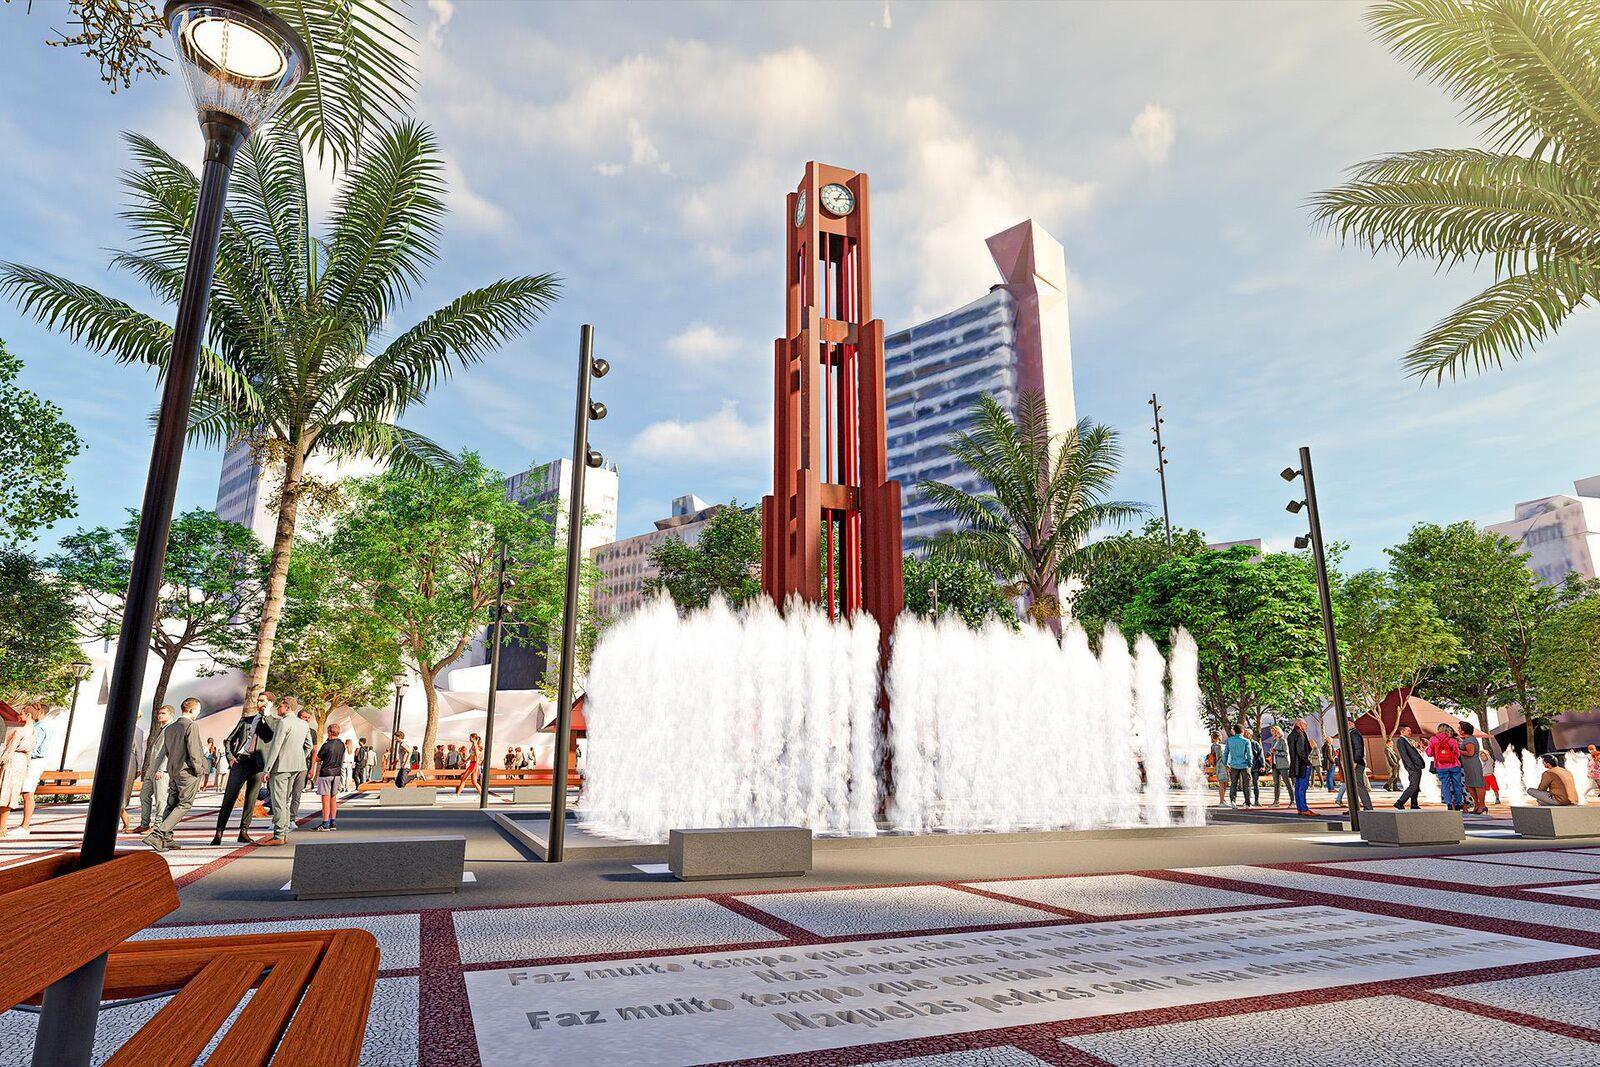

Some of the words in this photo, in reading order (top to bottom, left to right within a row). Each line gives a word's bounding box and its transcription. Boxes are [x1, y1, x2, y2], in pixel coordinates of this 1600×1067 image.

[508, 972, 576, 986] Faz
[584, 962, 685, 979] muito
[690, 955, 798, 970] tempo
[805, 950, 863, 962] que
[868, 946, 909, 954] eu
[907, 940, 966, 951] não
[962, 935, 1028, 946] vejo
[1045, 928, 1126, 939] verde
[1128, 950, 1245, 965] branco
[1230, 945, 1286, 955] da
[751, 969, 828, 983] Nas
[824, 955, 999, 976] longarinas
[995, 950, 1044, 960] da
[1036, 943, 1124, 959] ponte
[1114, 937, 1201, 948] velha
[1046, 960, 1122, 975] vejo
[1117, 960, 1148, 968] o
[939, 975, 990, 986] eu
[983, 967, 1053, 982] não
[739, 987, 864, 1007] tempo
[772, 1000, 969, 1031] Naquelas
[964, 987, 1096, 1013] pedras
[1090, 979, 1173, 994] com
[1161, 976, 1201, 986] a
[1186, 970, 1259, 983] sua
[1244, 960, 1352, 976] eterna
[1317, 953, 1419, 966] briga
[868, 979, 938, 997] que
[615, 997, 734, 1020] muito
[526, 1011, 607, 1030] Faz
